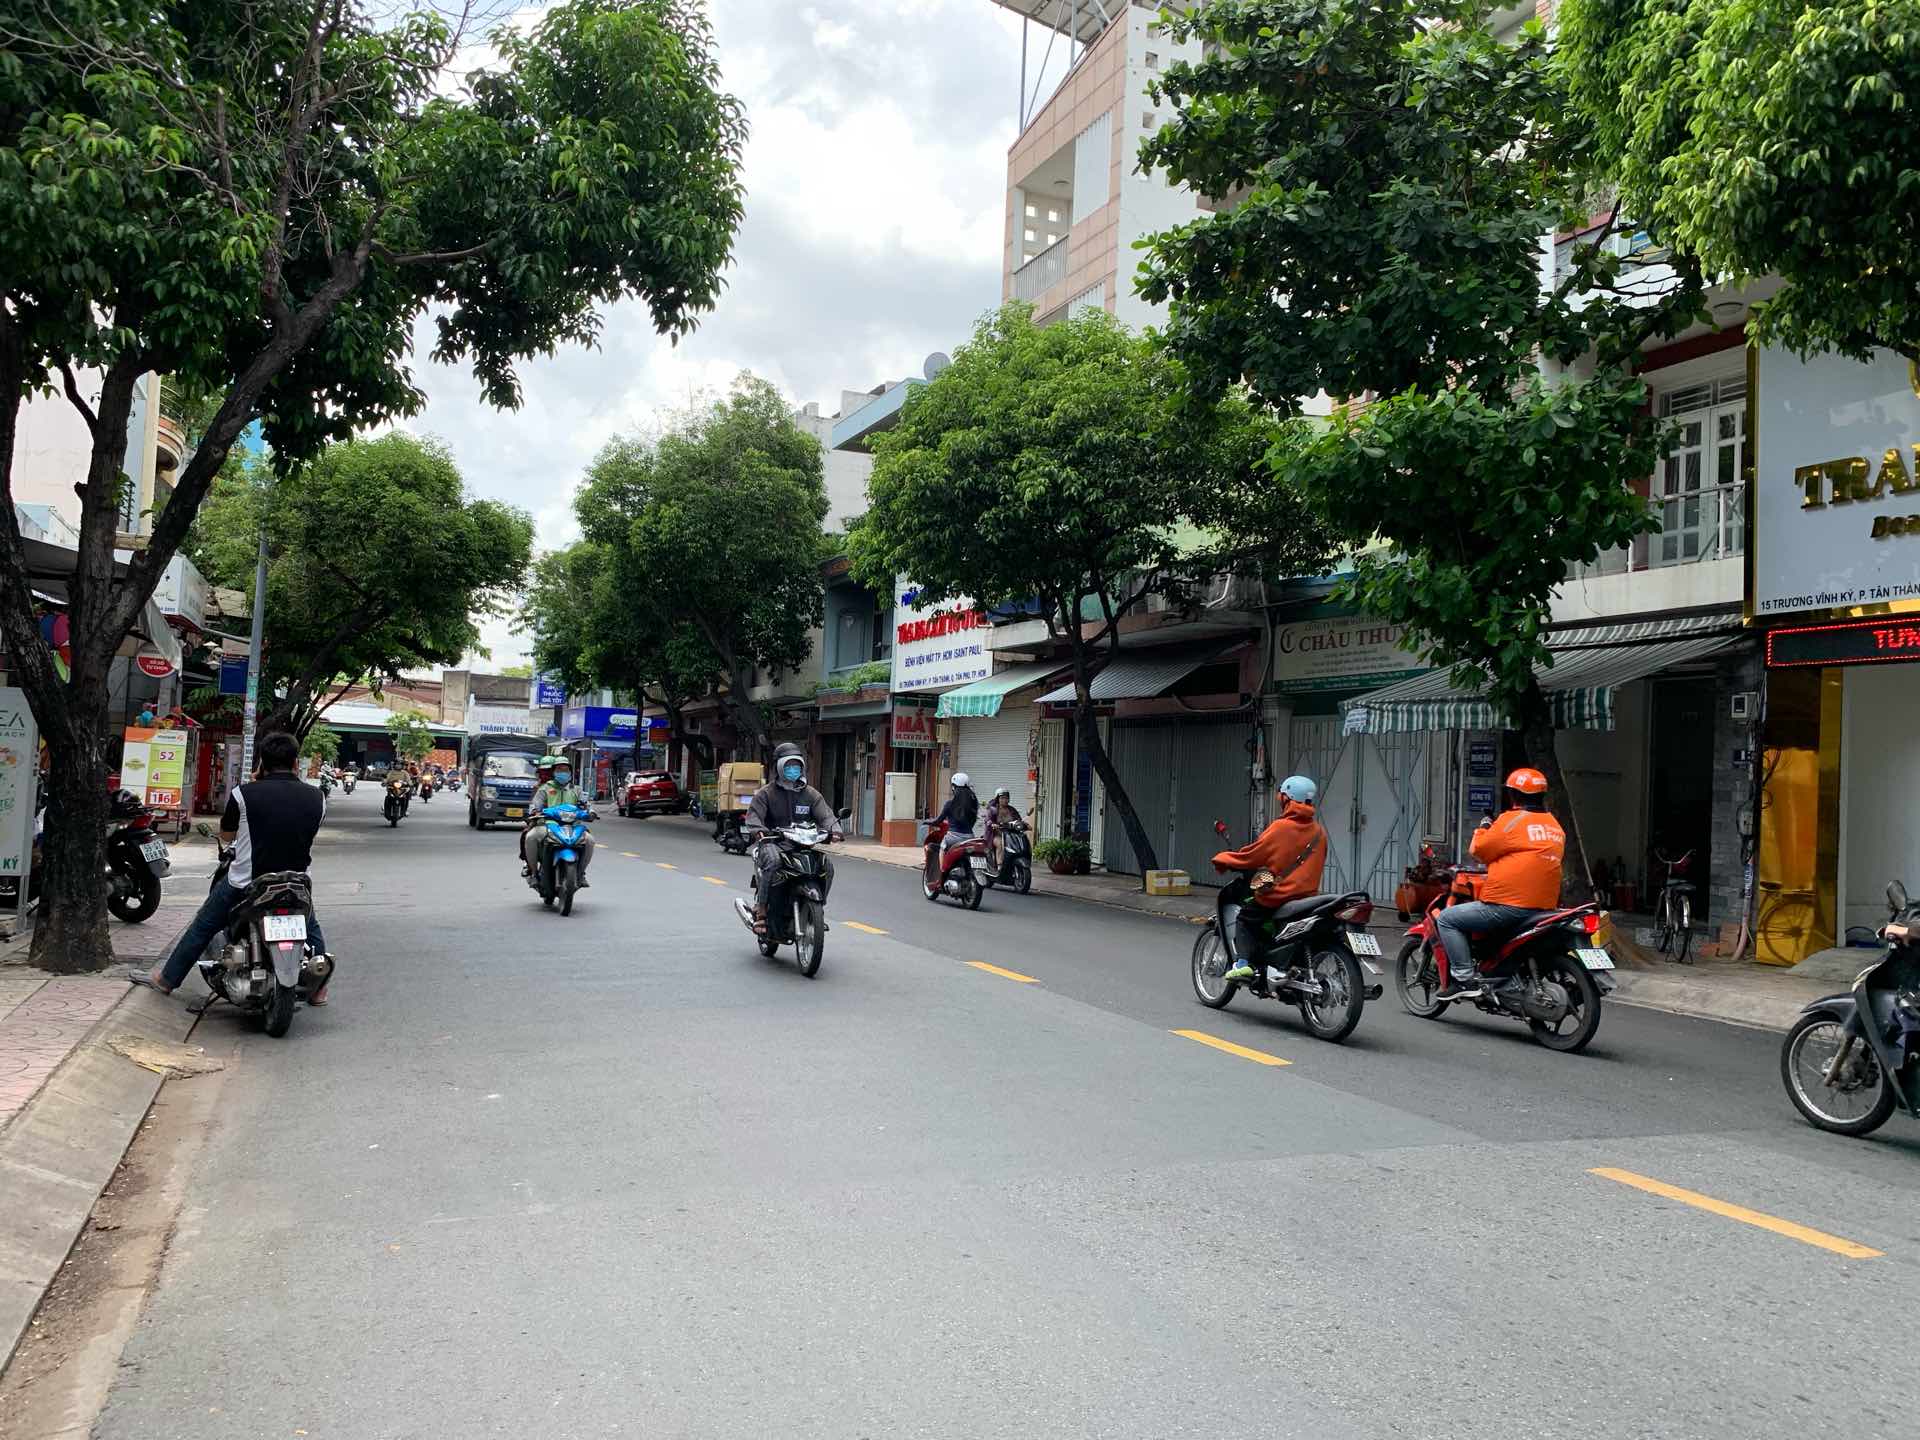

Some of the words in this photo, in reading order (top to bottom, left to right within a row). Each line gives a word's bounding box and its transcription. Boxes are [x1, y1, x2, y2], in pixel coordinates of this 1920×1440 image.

[1794, 443, 1920, 512] TRA
[1761, 600, 1771, 610] 15
[1773, 595, 1813, 608] TRƯƠNG
[1815, 592, 1838, 605] VĨNH
[1869, 585, 1890, 599] TÂN
[1299, 630, 1351, 652] CHÂU
[160, 751, 175, 760] 52
[152, 773, 160, 781] 4
[3, 855, 18, 870] KÝ
